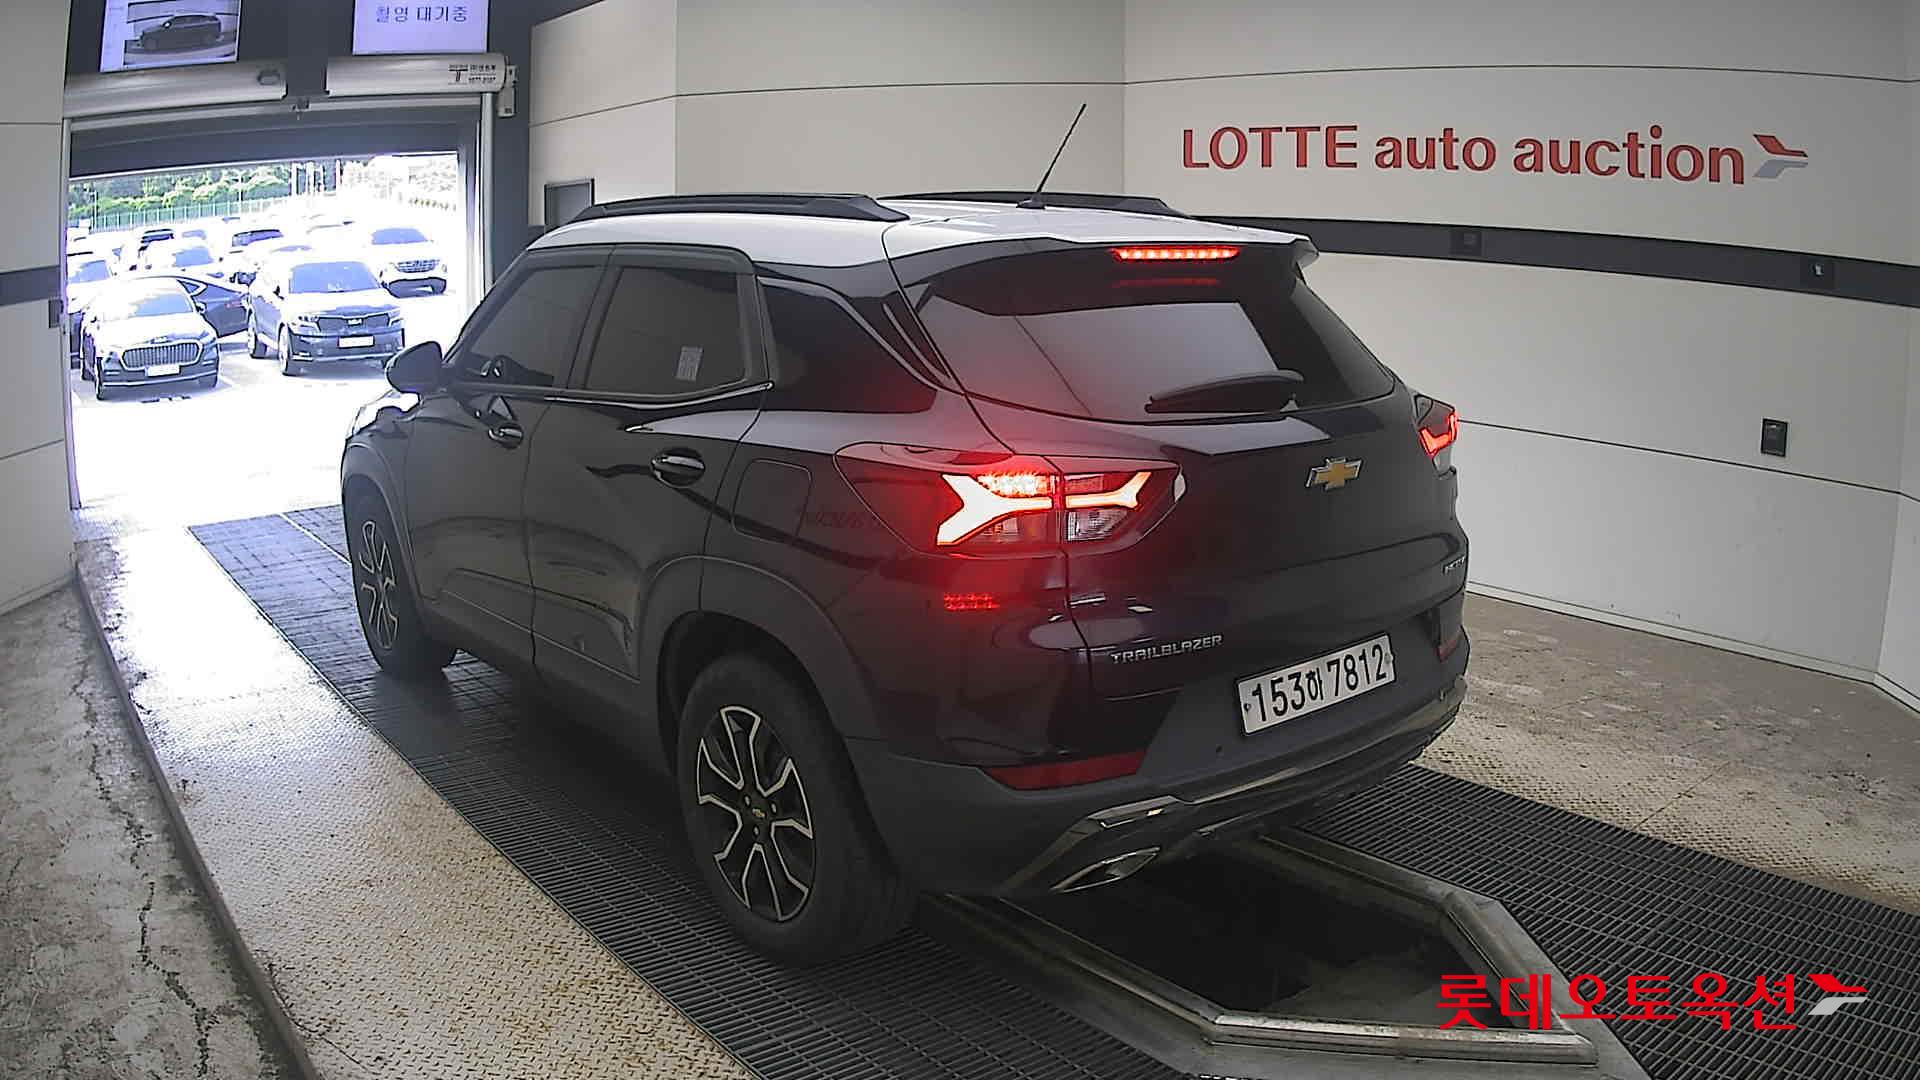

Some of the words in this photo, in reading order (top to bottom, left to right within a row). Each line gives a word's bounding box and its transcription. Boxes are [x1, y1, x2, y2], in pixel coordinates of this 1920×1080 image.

[1183, 125, 1358, 170] LOTTE
[1375, 127, 1497, 171] auto
[1513, 124, 1745, 185] auction
[1110, 634, 1223, 664] TRAILBLAZER
